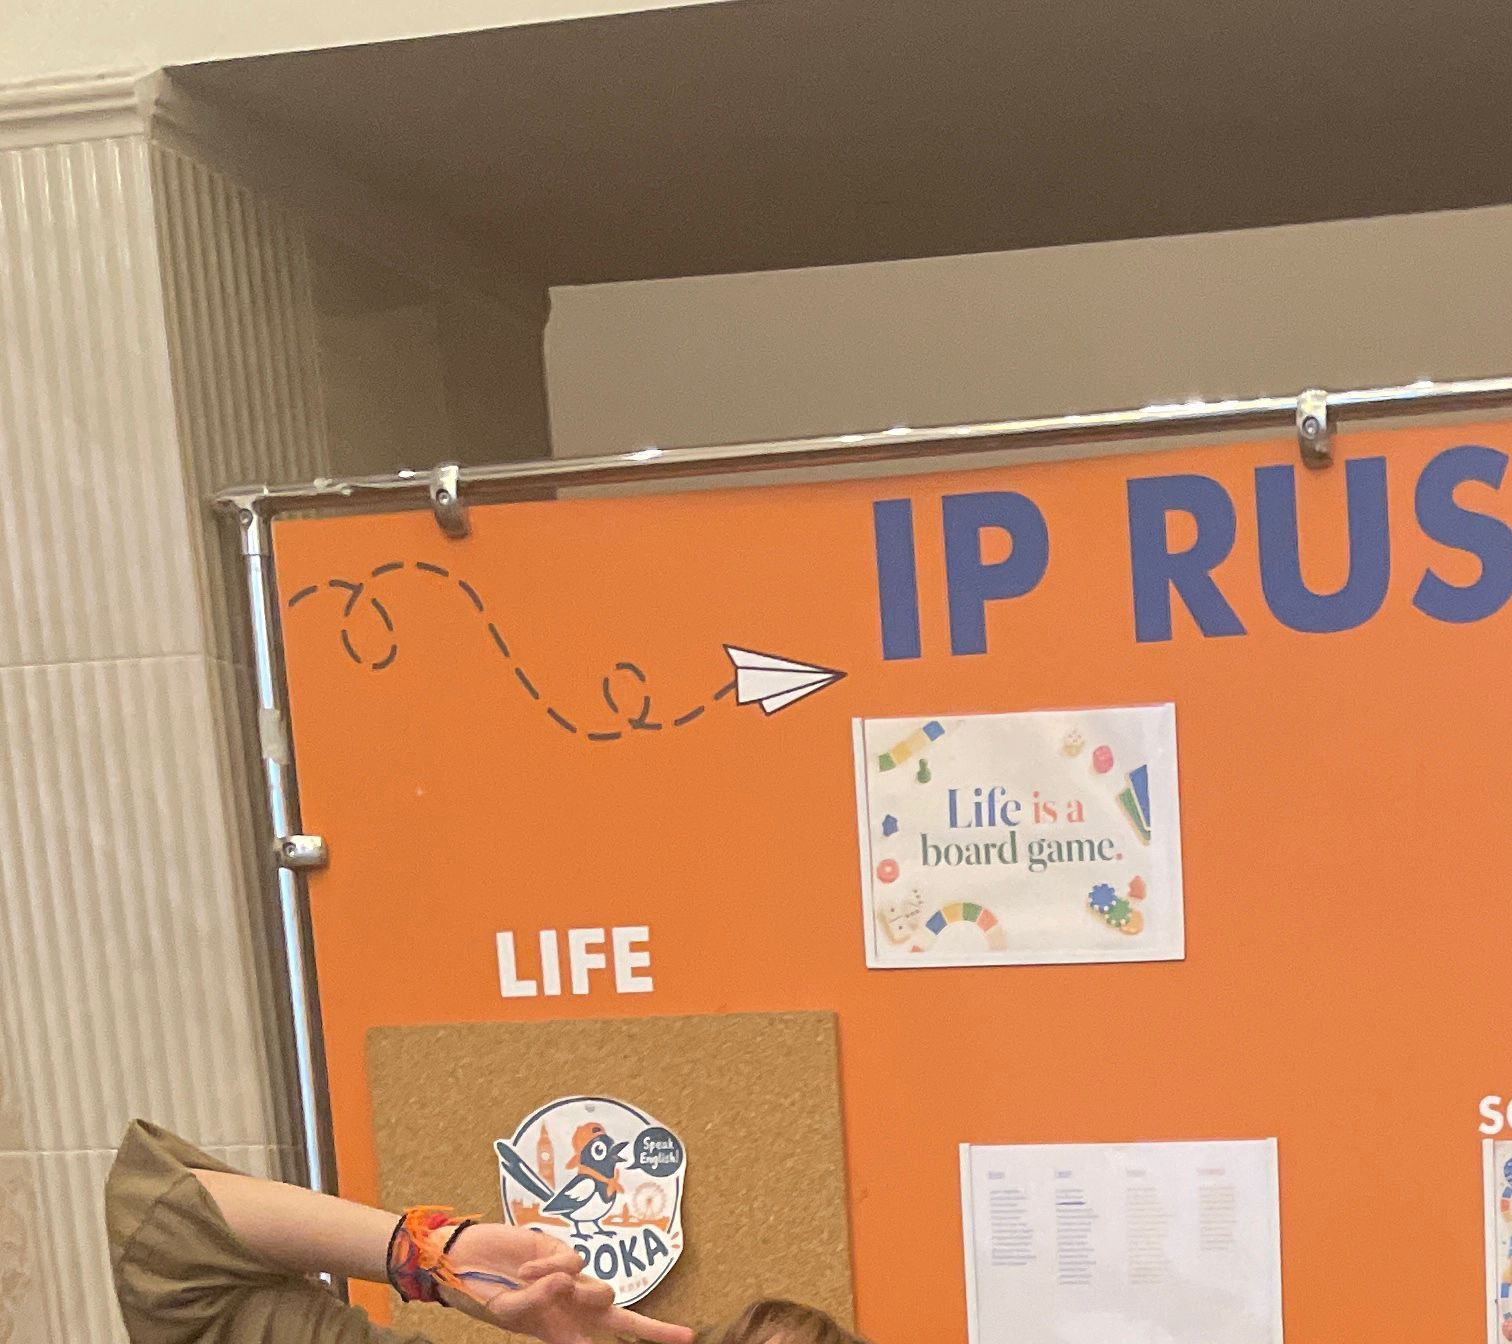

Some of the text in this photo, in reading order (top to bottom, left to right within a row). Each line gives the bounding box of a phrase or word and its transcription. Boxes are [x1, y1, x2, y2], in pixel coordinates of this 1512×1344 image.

[873, 491, 1049, 660] IP
[948, 786, 1085, 828] Life is a
[921, 831, 1123, 873] board game.
[496, 925, 653, 998] LIFE
[643, 1136, 674, 1153] Speak
